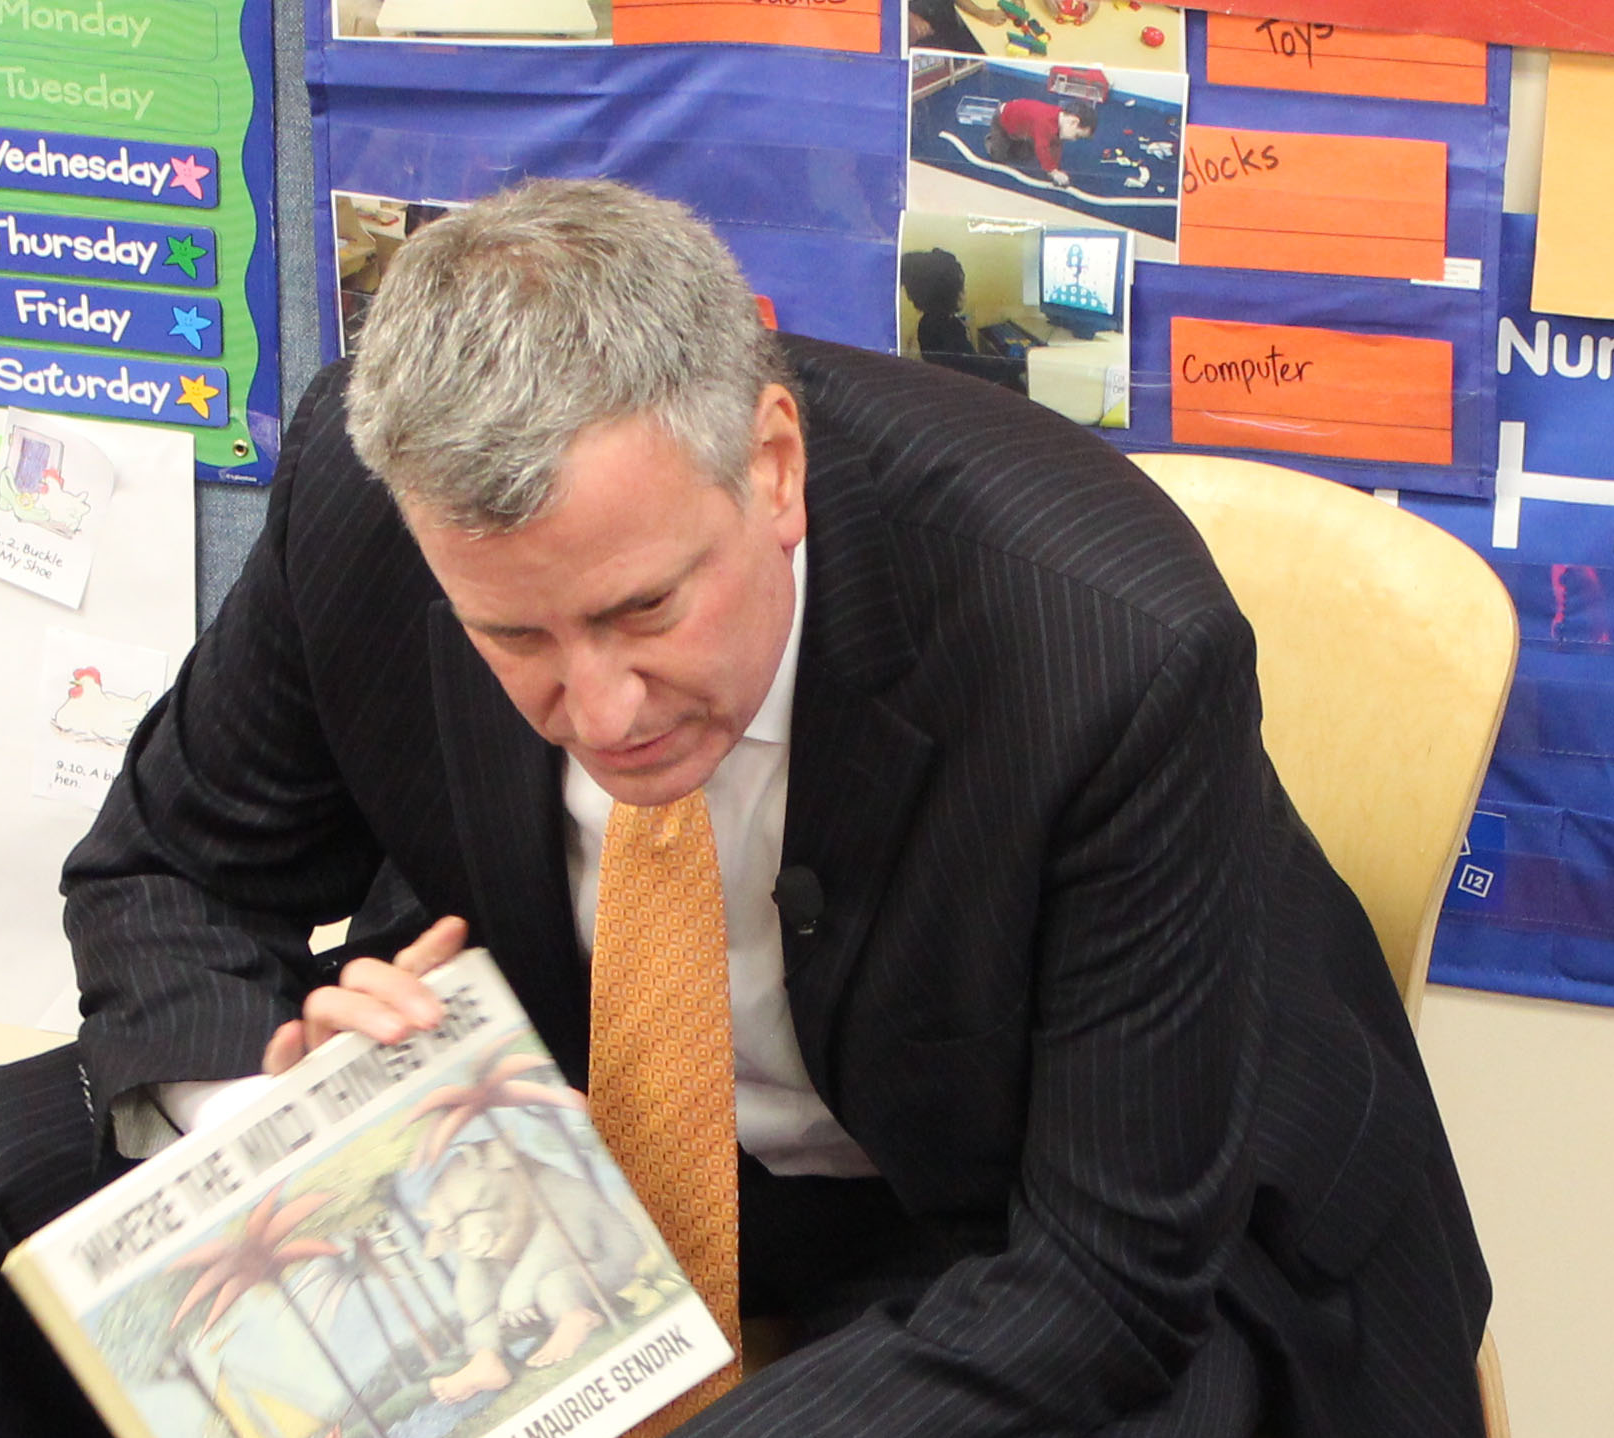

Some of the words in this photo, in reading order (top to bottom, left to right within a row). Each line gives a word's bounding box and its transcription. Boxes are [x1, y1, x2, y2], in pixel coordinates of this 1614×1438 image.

[14, 290, 132, 342] Friday
[1182, 345, 1314, 392] Computer
[22, 543, 63, 568] Buckle
[22, 559, 53, 580] Shoe
[89, 768, 99, 779] A
[1466, 872, 1485, 889] 12
[70, 1188, 186, 1287] WHERE
[174, 1149, 243, 1207] THE
[236, 1102, 316, 1176] WILD
[308, 1040, 424, 1126] THINGS
[608, 1324, 697, 1395] SENDAK
